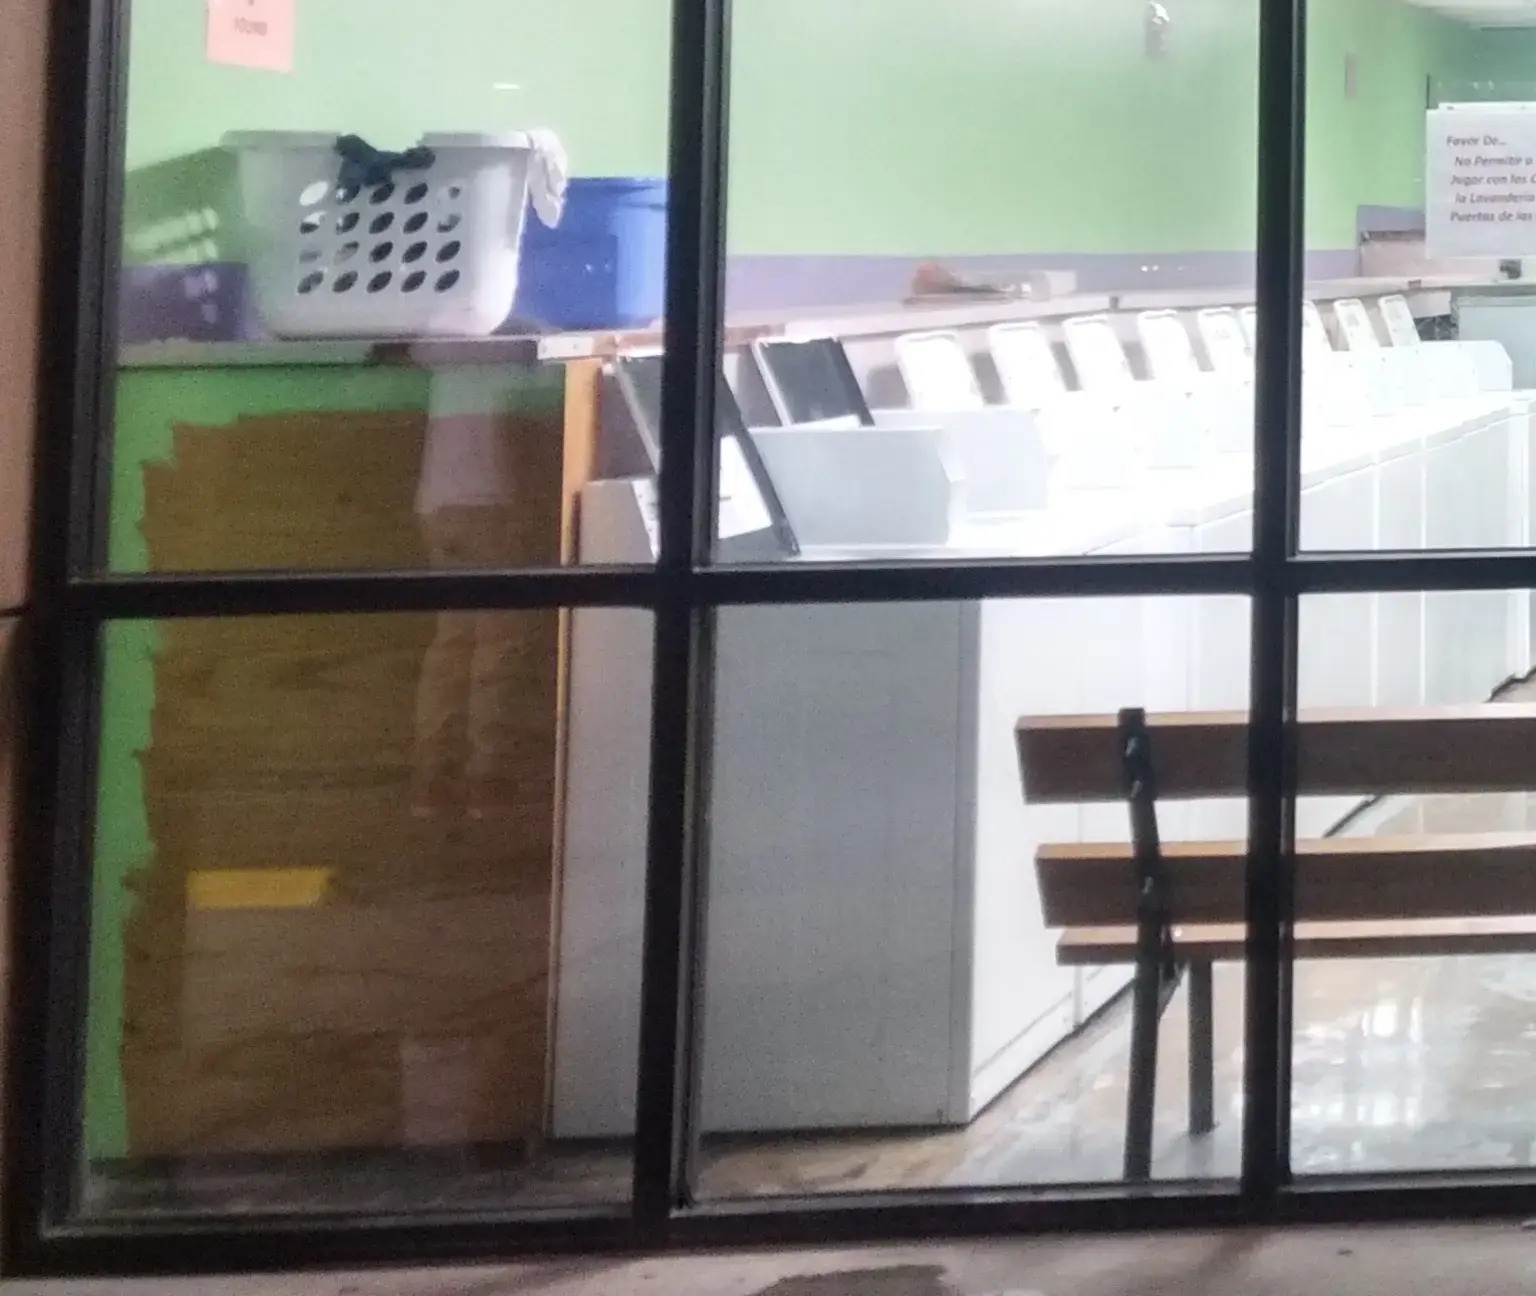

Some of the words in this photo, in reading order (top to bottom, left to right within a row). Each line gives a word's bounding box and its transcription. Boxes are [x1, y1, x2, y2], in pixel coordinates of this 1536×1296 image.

[1446, 135, 1479, 146] Favor
[1455, 156, 1471, 166] No
[1474, 155, 1522, 166] Permitir
[1451, 174, 1484, 187] Jugar
[1486, 176, 1508, 185] con
[1450, 211, 1494, 222] Puertas
[1498, 211, 1514, 221] de
